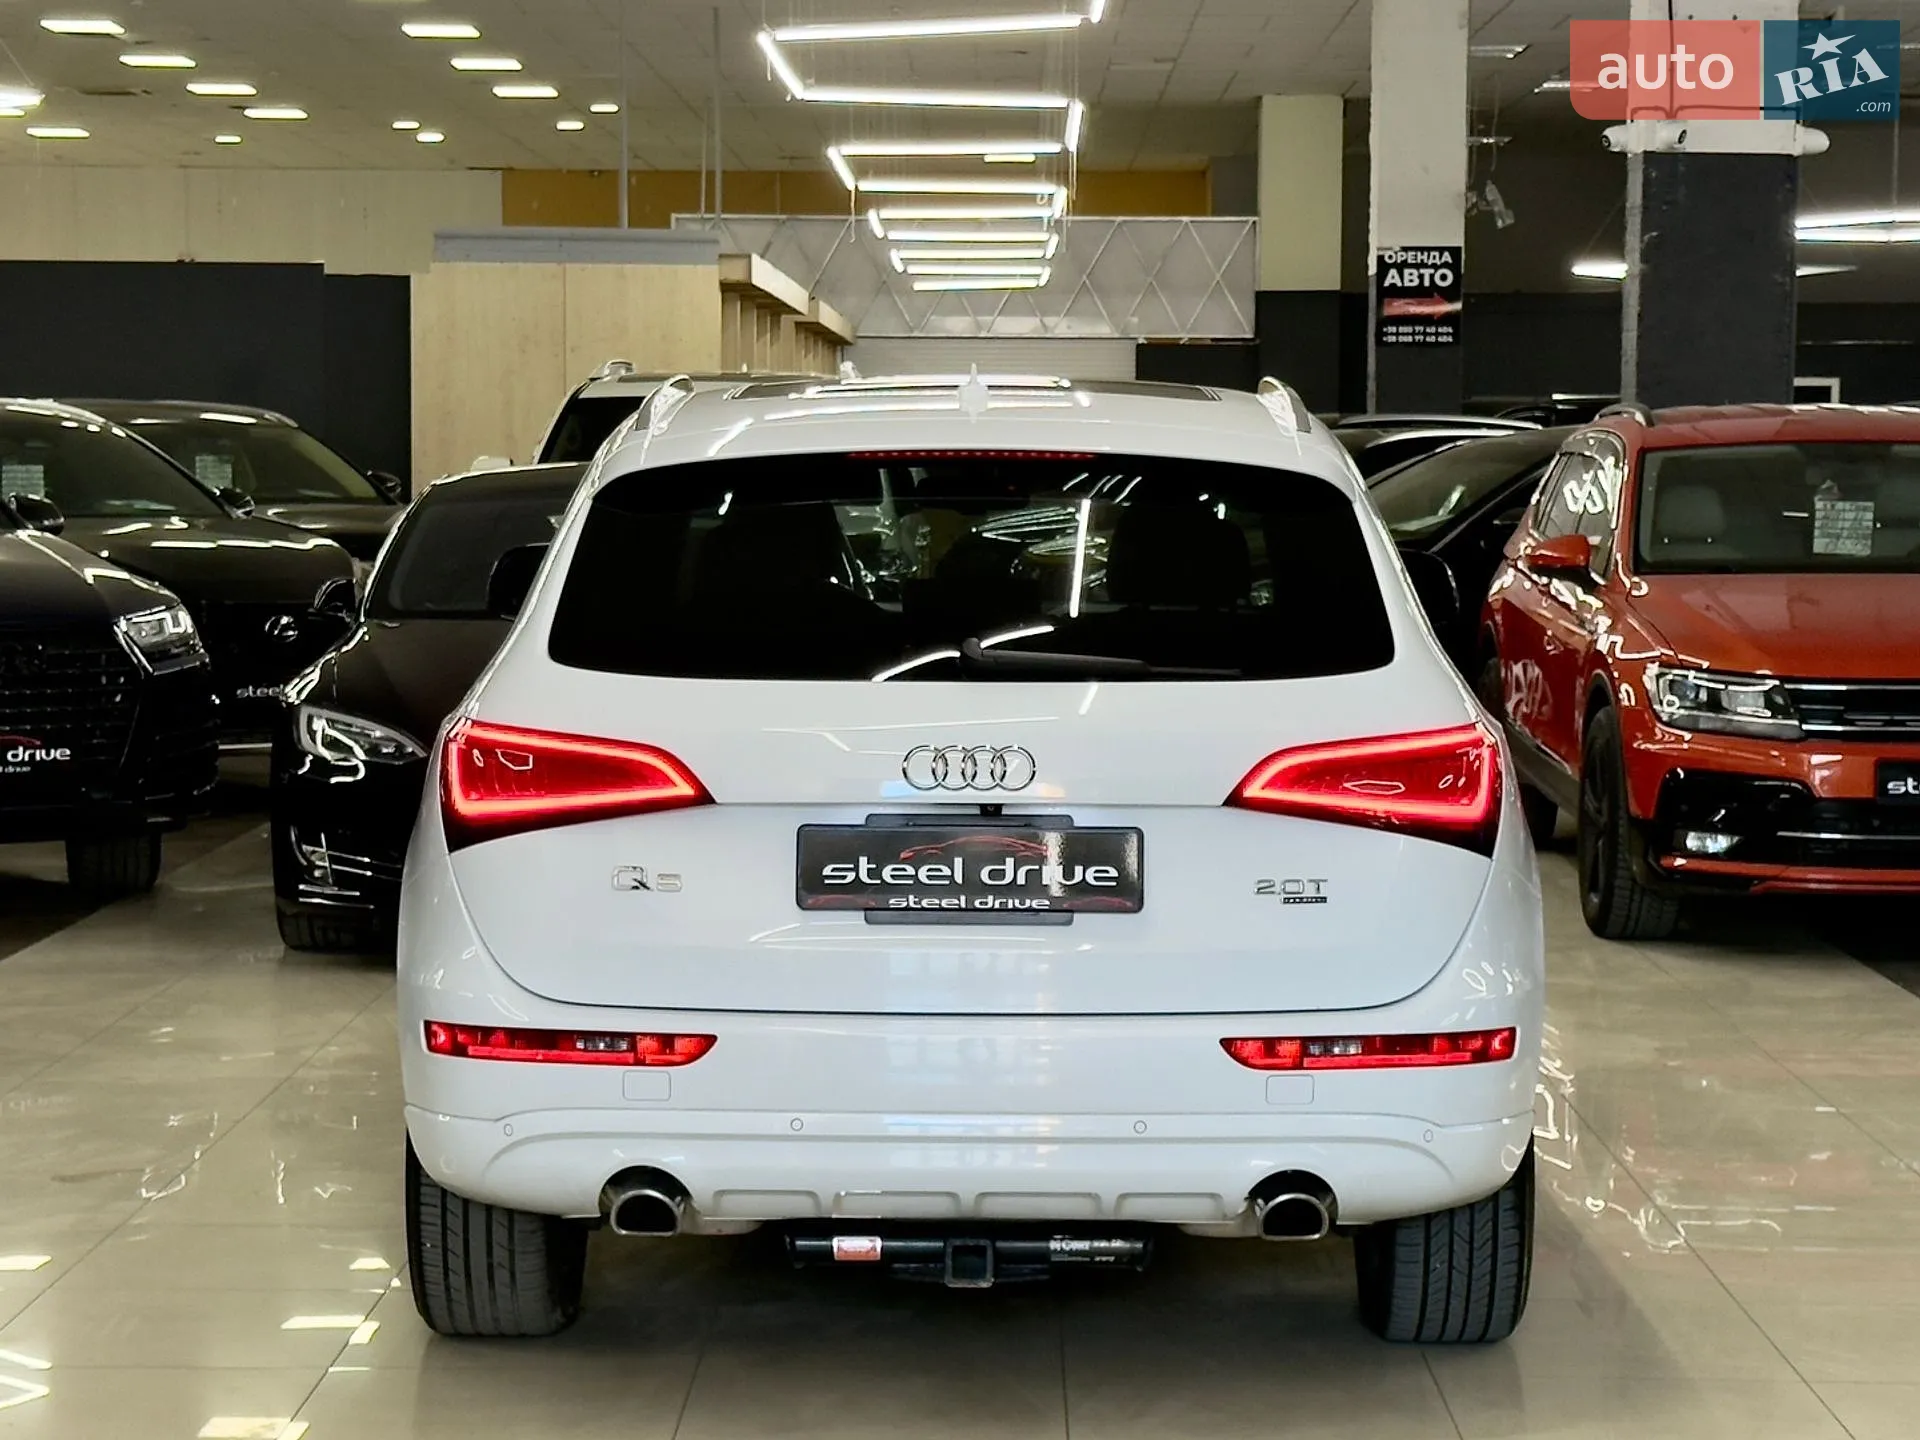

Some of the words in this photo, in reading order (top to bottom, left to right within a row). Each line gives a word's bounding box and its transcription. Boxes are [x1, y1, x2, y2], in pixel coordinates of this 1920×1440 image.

[1384, 251, 1453, 265] ОРЕНДА
[1383, 268, 1454, 287] АВТО
[6, 745, 71, 762] drive
[611, 864, 683, 893] Q5
[821, 856, 963, 886] steel
[979, 857, 1119, 887] drive
[888, 895, 966, 909] steel
[974, 895, 1051, 909] drive
